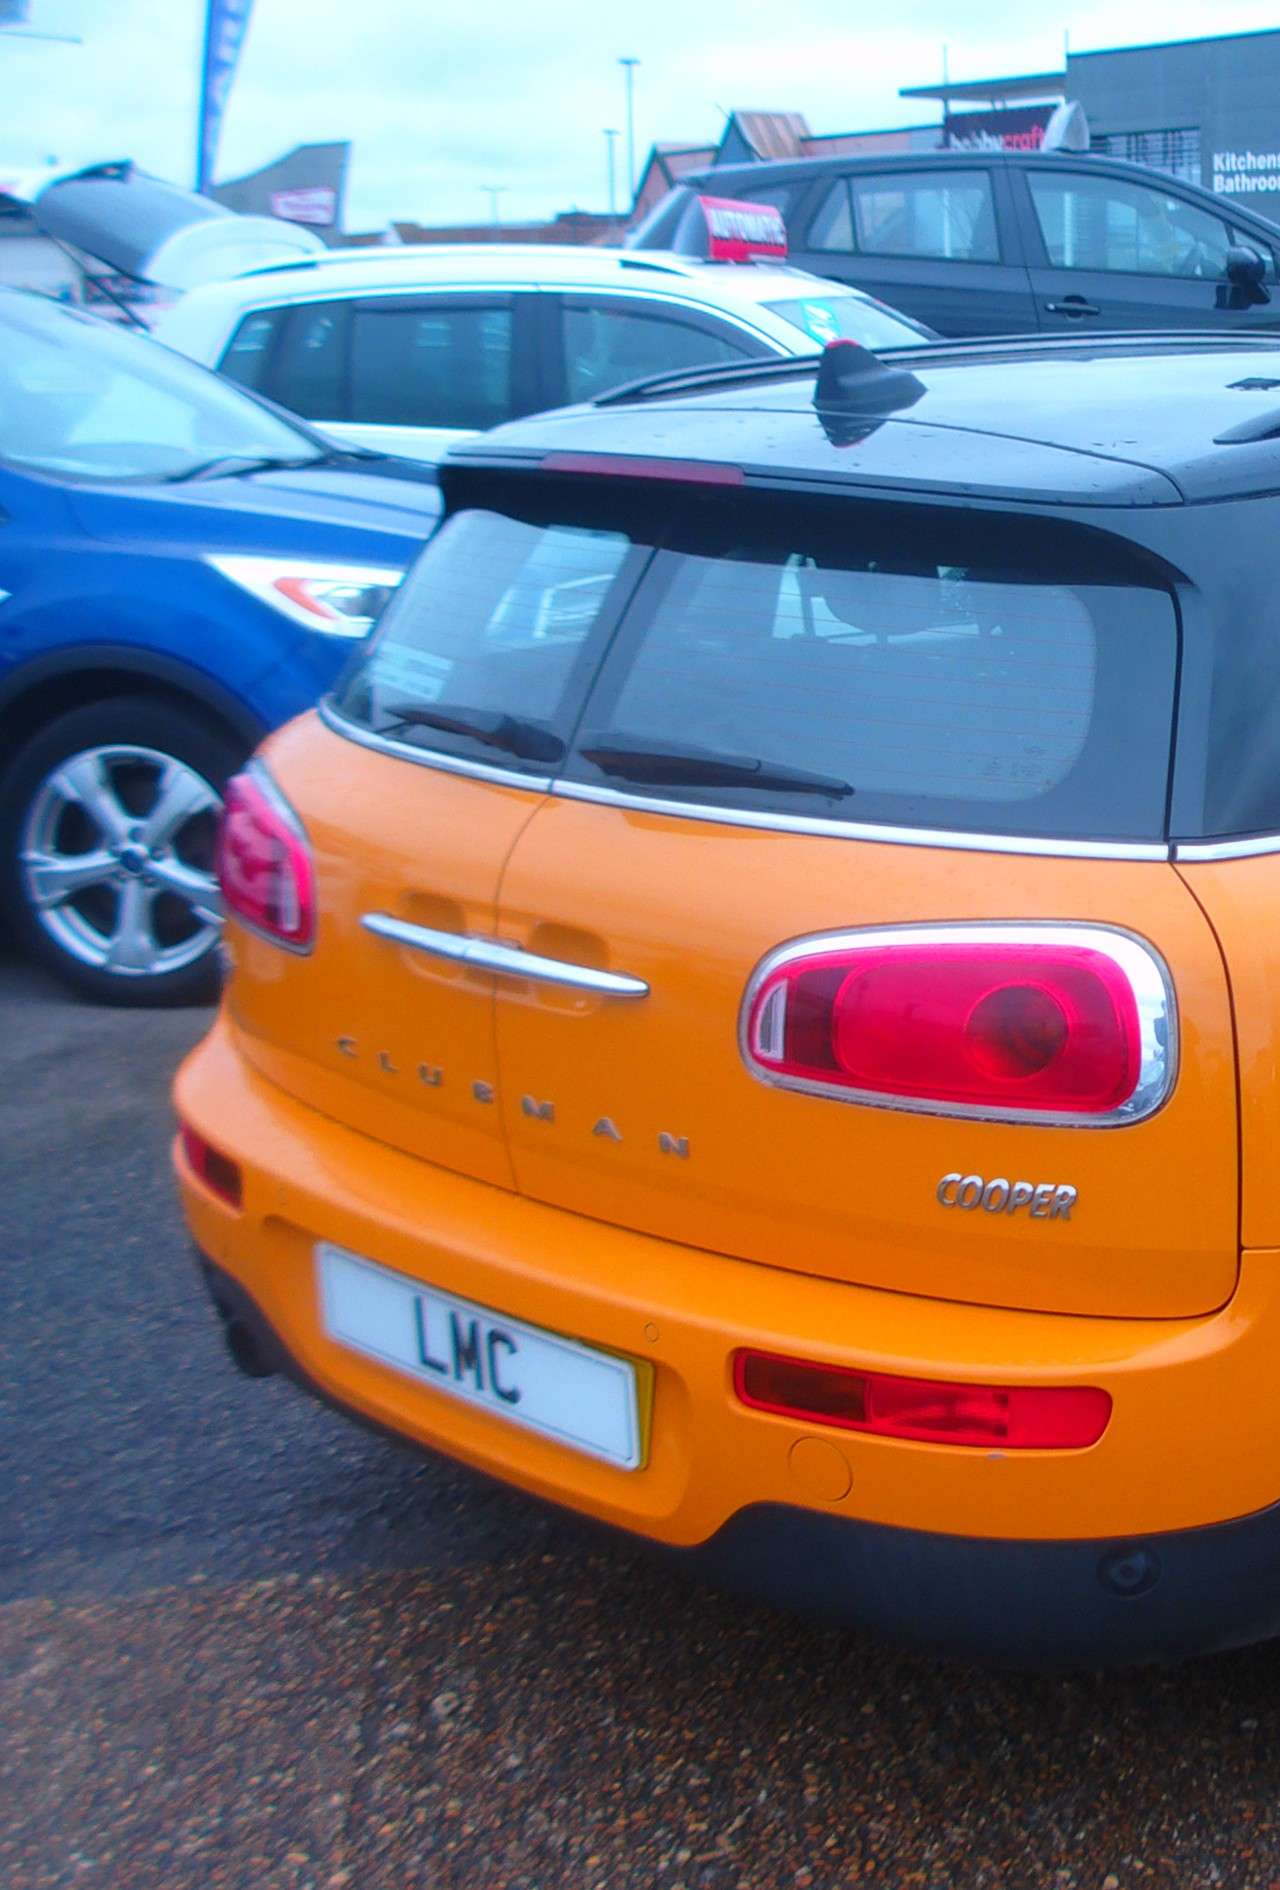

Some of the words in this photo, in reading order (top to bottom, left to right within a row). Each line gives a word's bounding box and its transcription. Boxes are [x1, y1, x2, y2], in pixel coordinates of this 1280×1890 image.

[710, 208, 787, 246] AUTOMATIC
[336, 1034, 691, 1160] CLUBMAN
[936, 1172, 1079, 1220] COOPER
[413, 1294, 521, 1406] LMC
